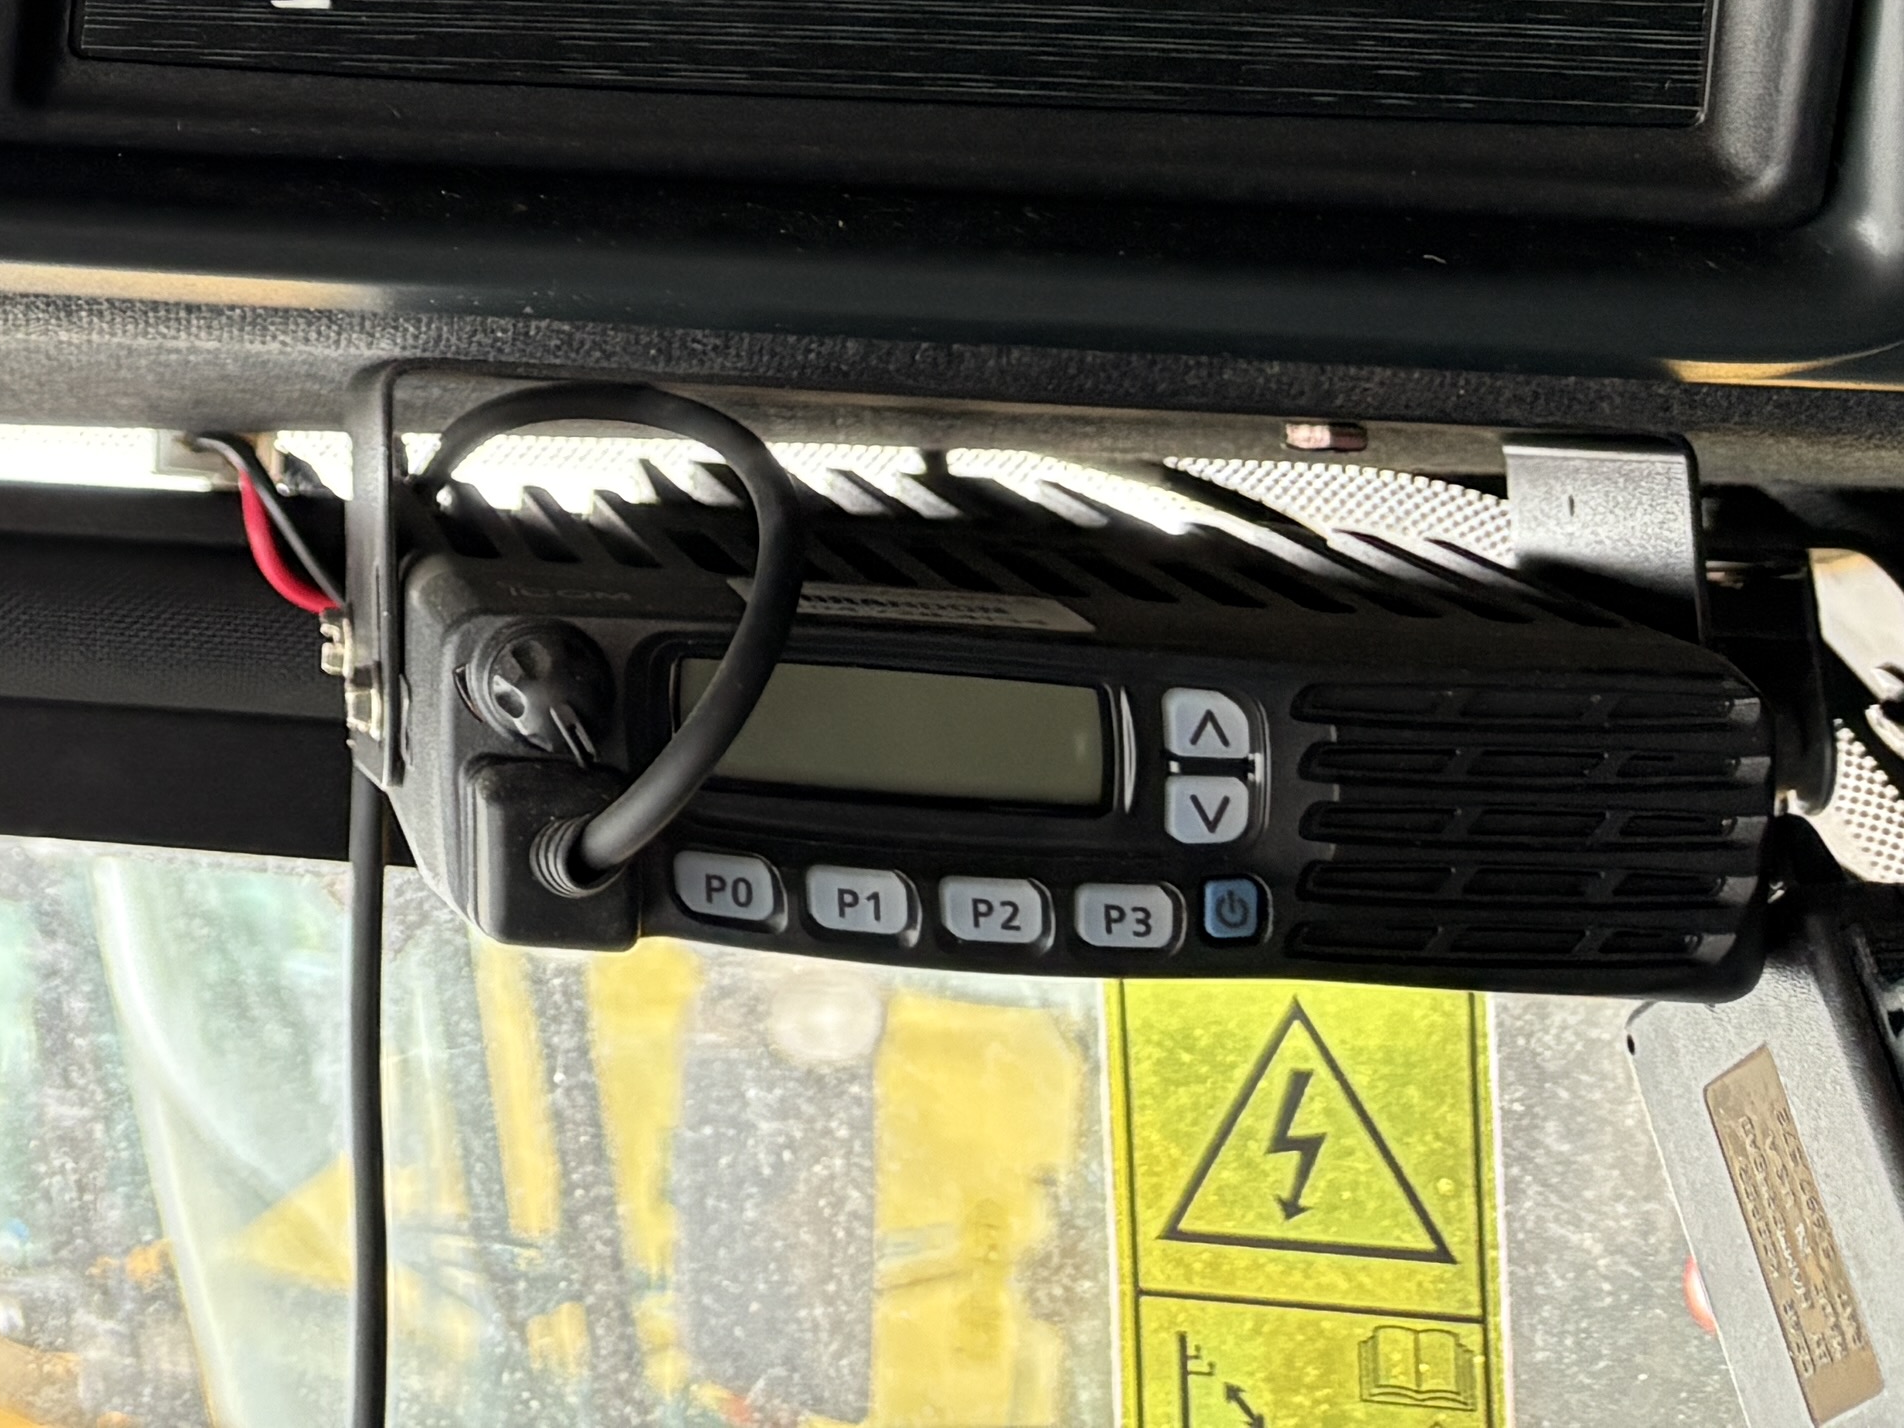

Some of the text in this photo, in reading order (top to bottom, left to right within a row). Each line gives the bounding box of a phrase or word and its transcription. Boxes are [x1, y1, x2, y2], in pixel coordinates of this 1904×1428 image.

[704, 873, 753, 908] P0
[837, 887, 882, 922] P1
[971, 897, 1022, 932] P2
[1103, 903, 1153, 938] P3
